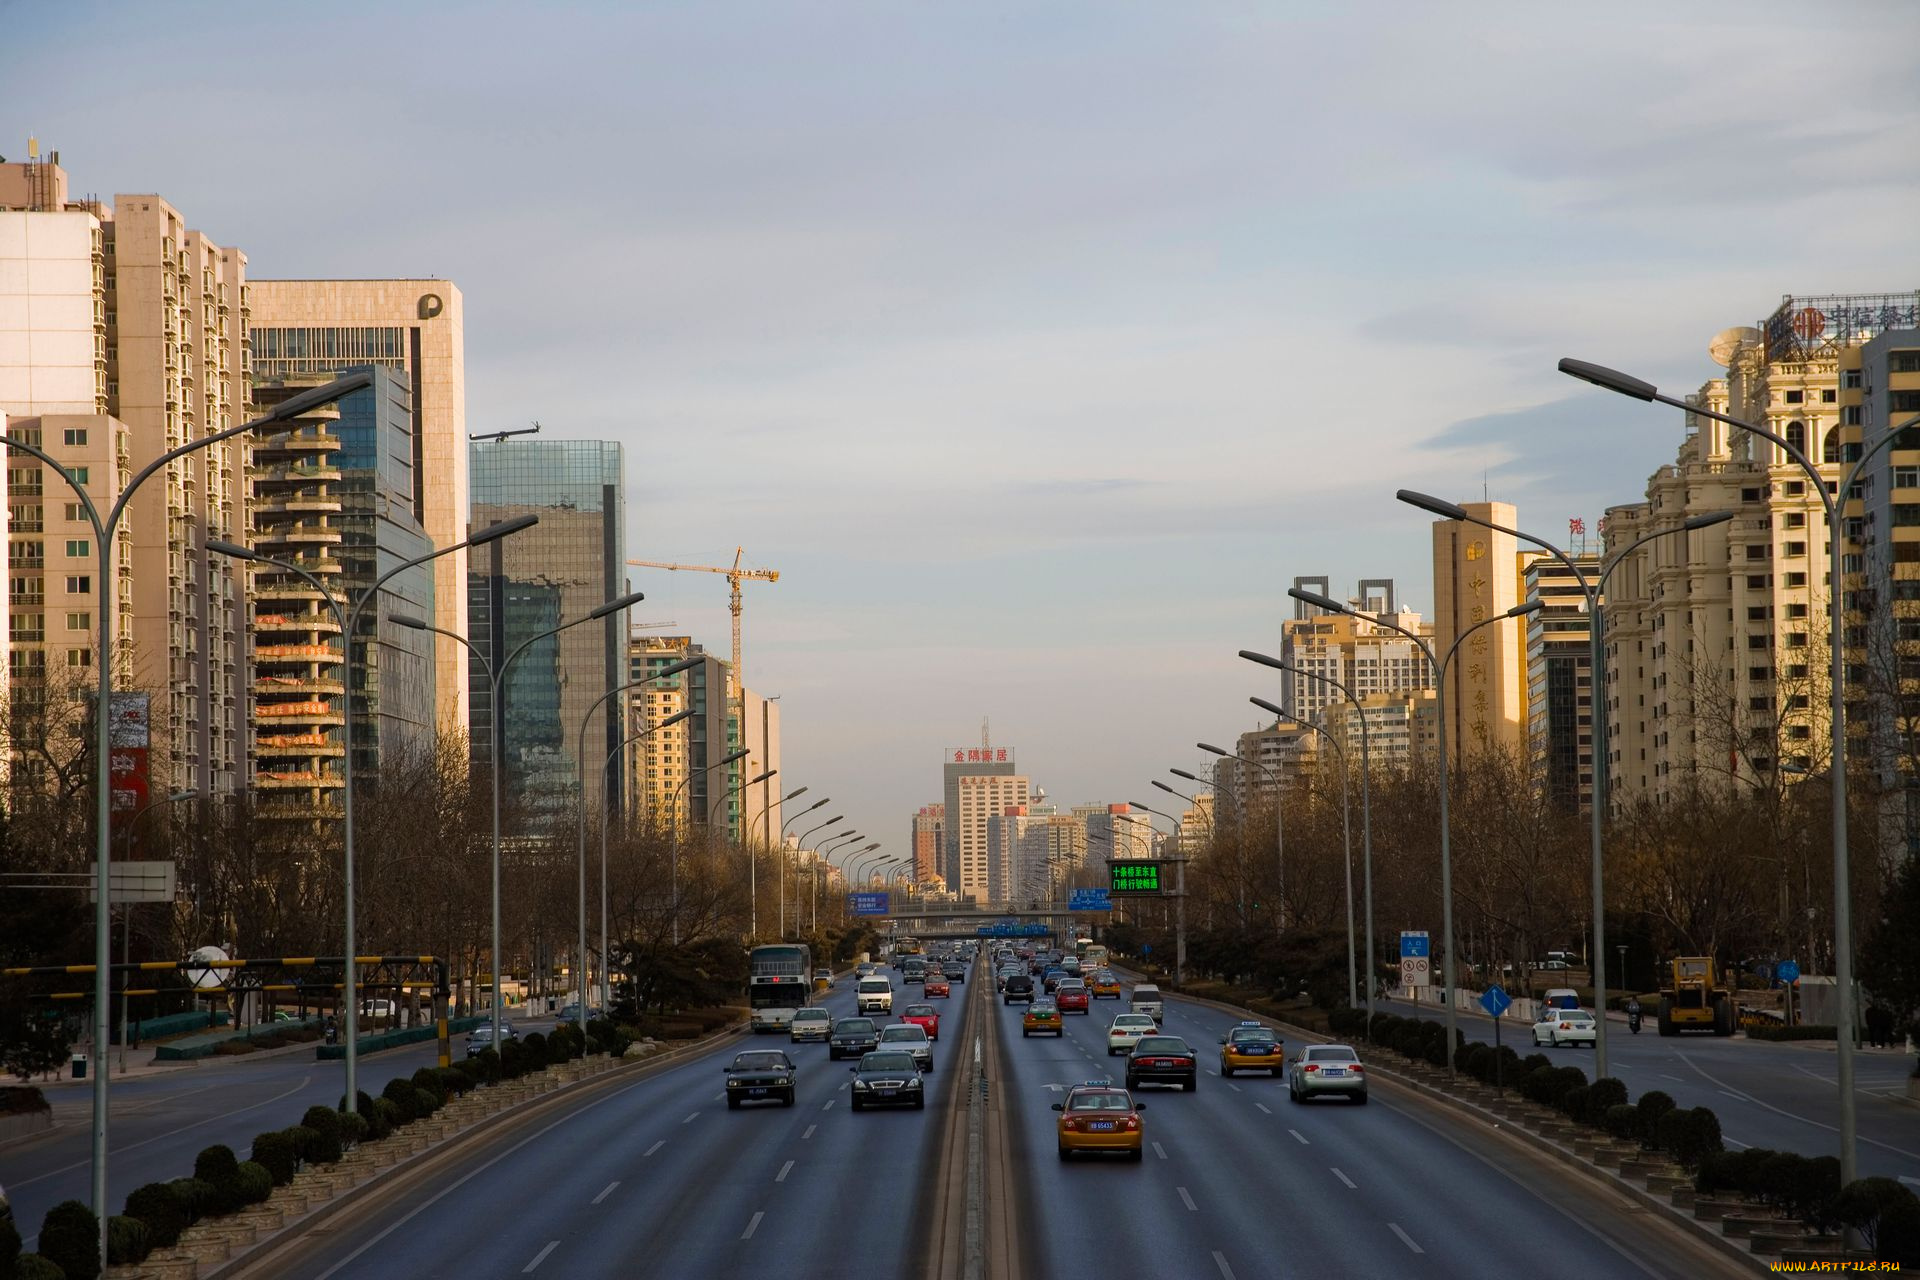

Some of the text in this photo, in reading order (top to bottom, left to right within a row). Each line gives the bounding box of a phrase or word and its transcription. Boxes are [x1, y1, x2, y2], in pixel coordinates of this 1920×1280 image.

[1112, 866, 1158, 878] 十条桥至东直
